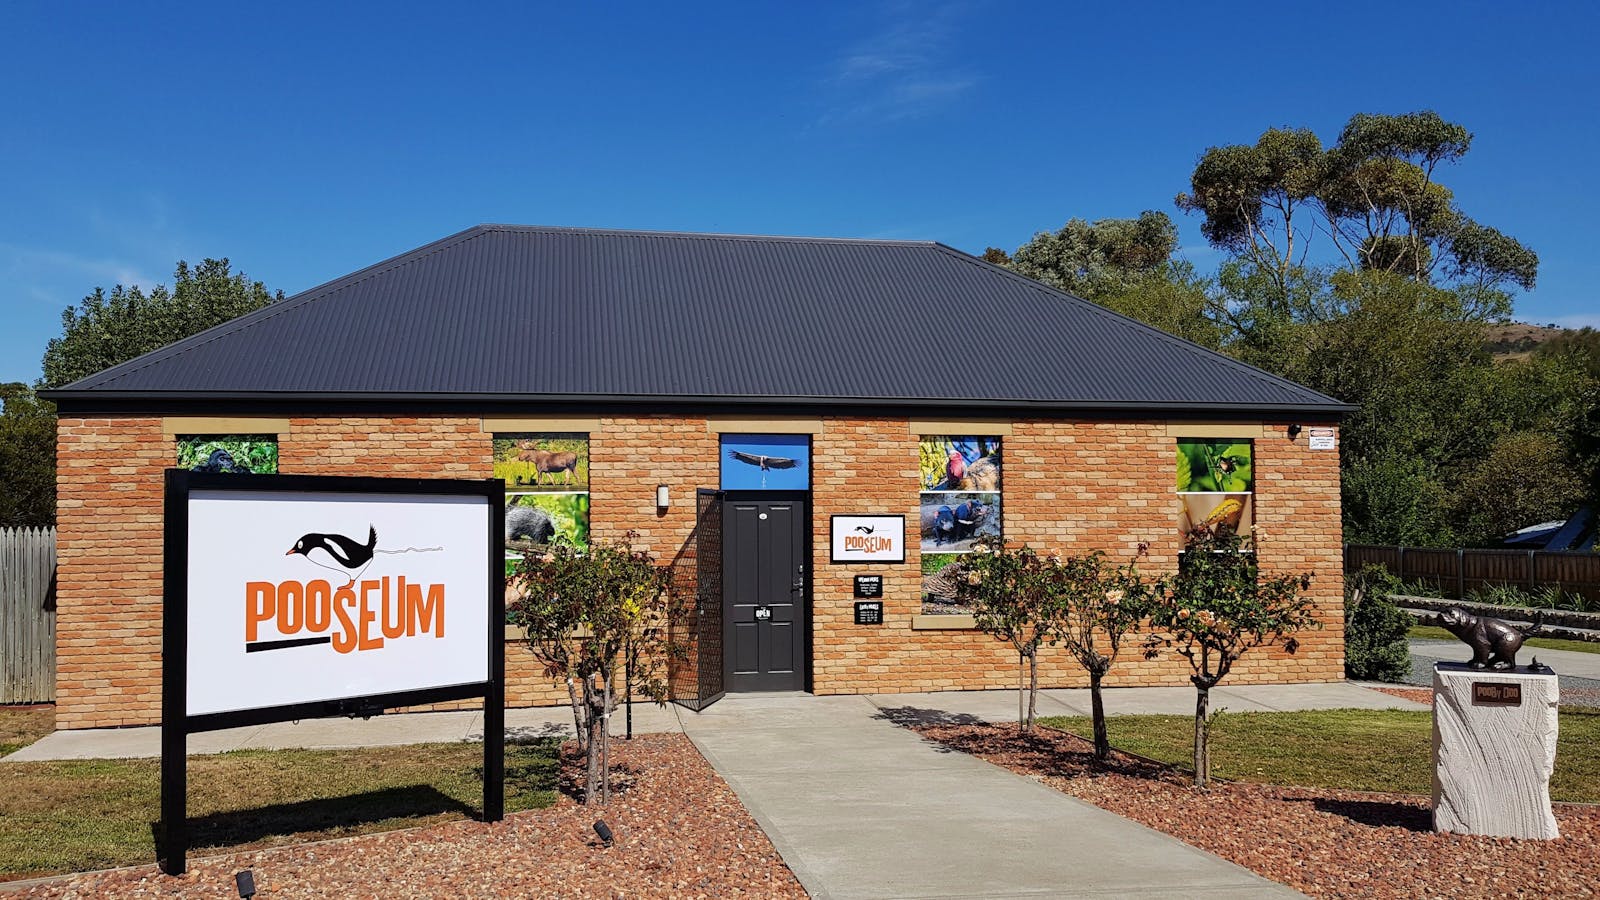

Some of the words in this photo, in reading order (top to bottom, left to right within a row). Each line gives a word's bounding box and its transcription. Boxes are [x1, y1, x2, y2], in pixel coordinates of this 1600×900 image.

[845, 535, 892, 554] POOSEUM
[246, 575, 445, 654] POOSEUM
[756, 608, 771, 618] OPEN
